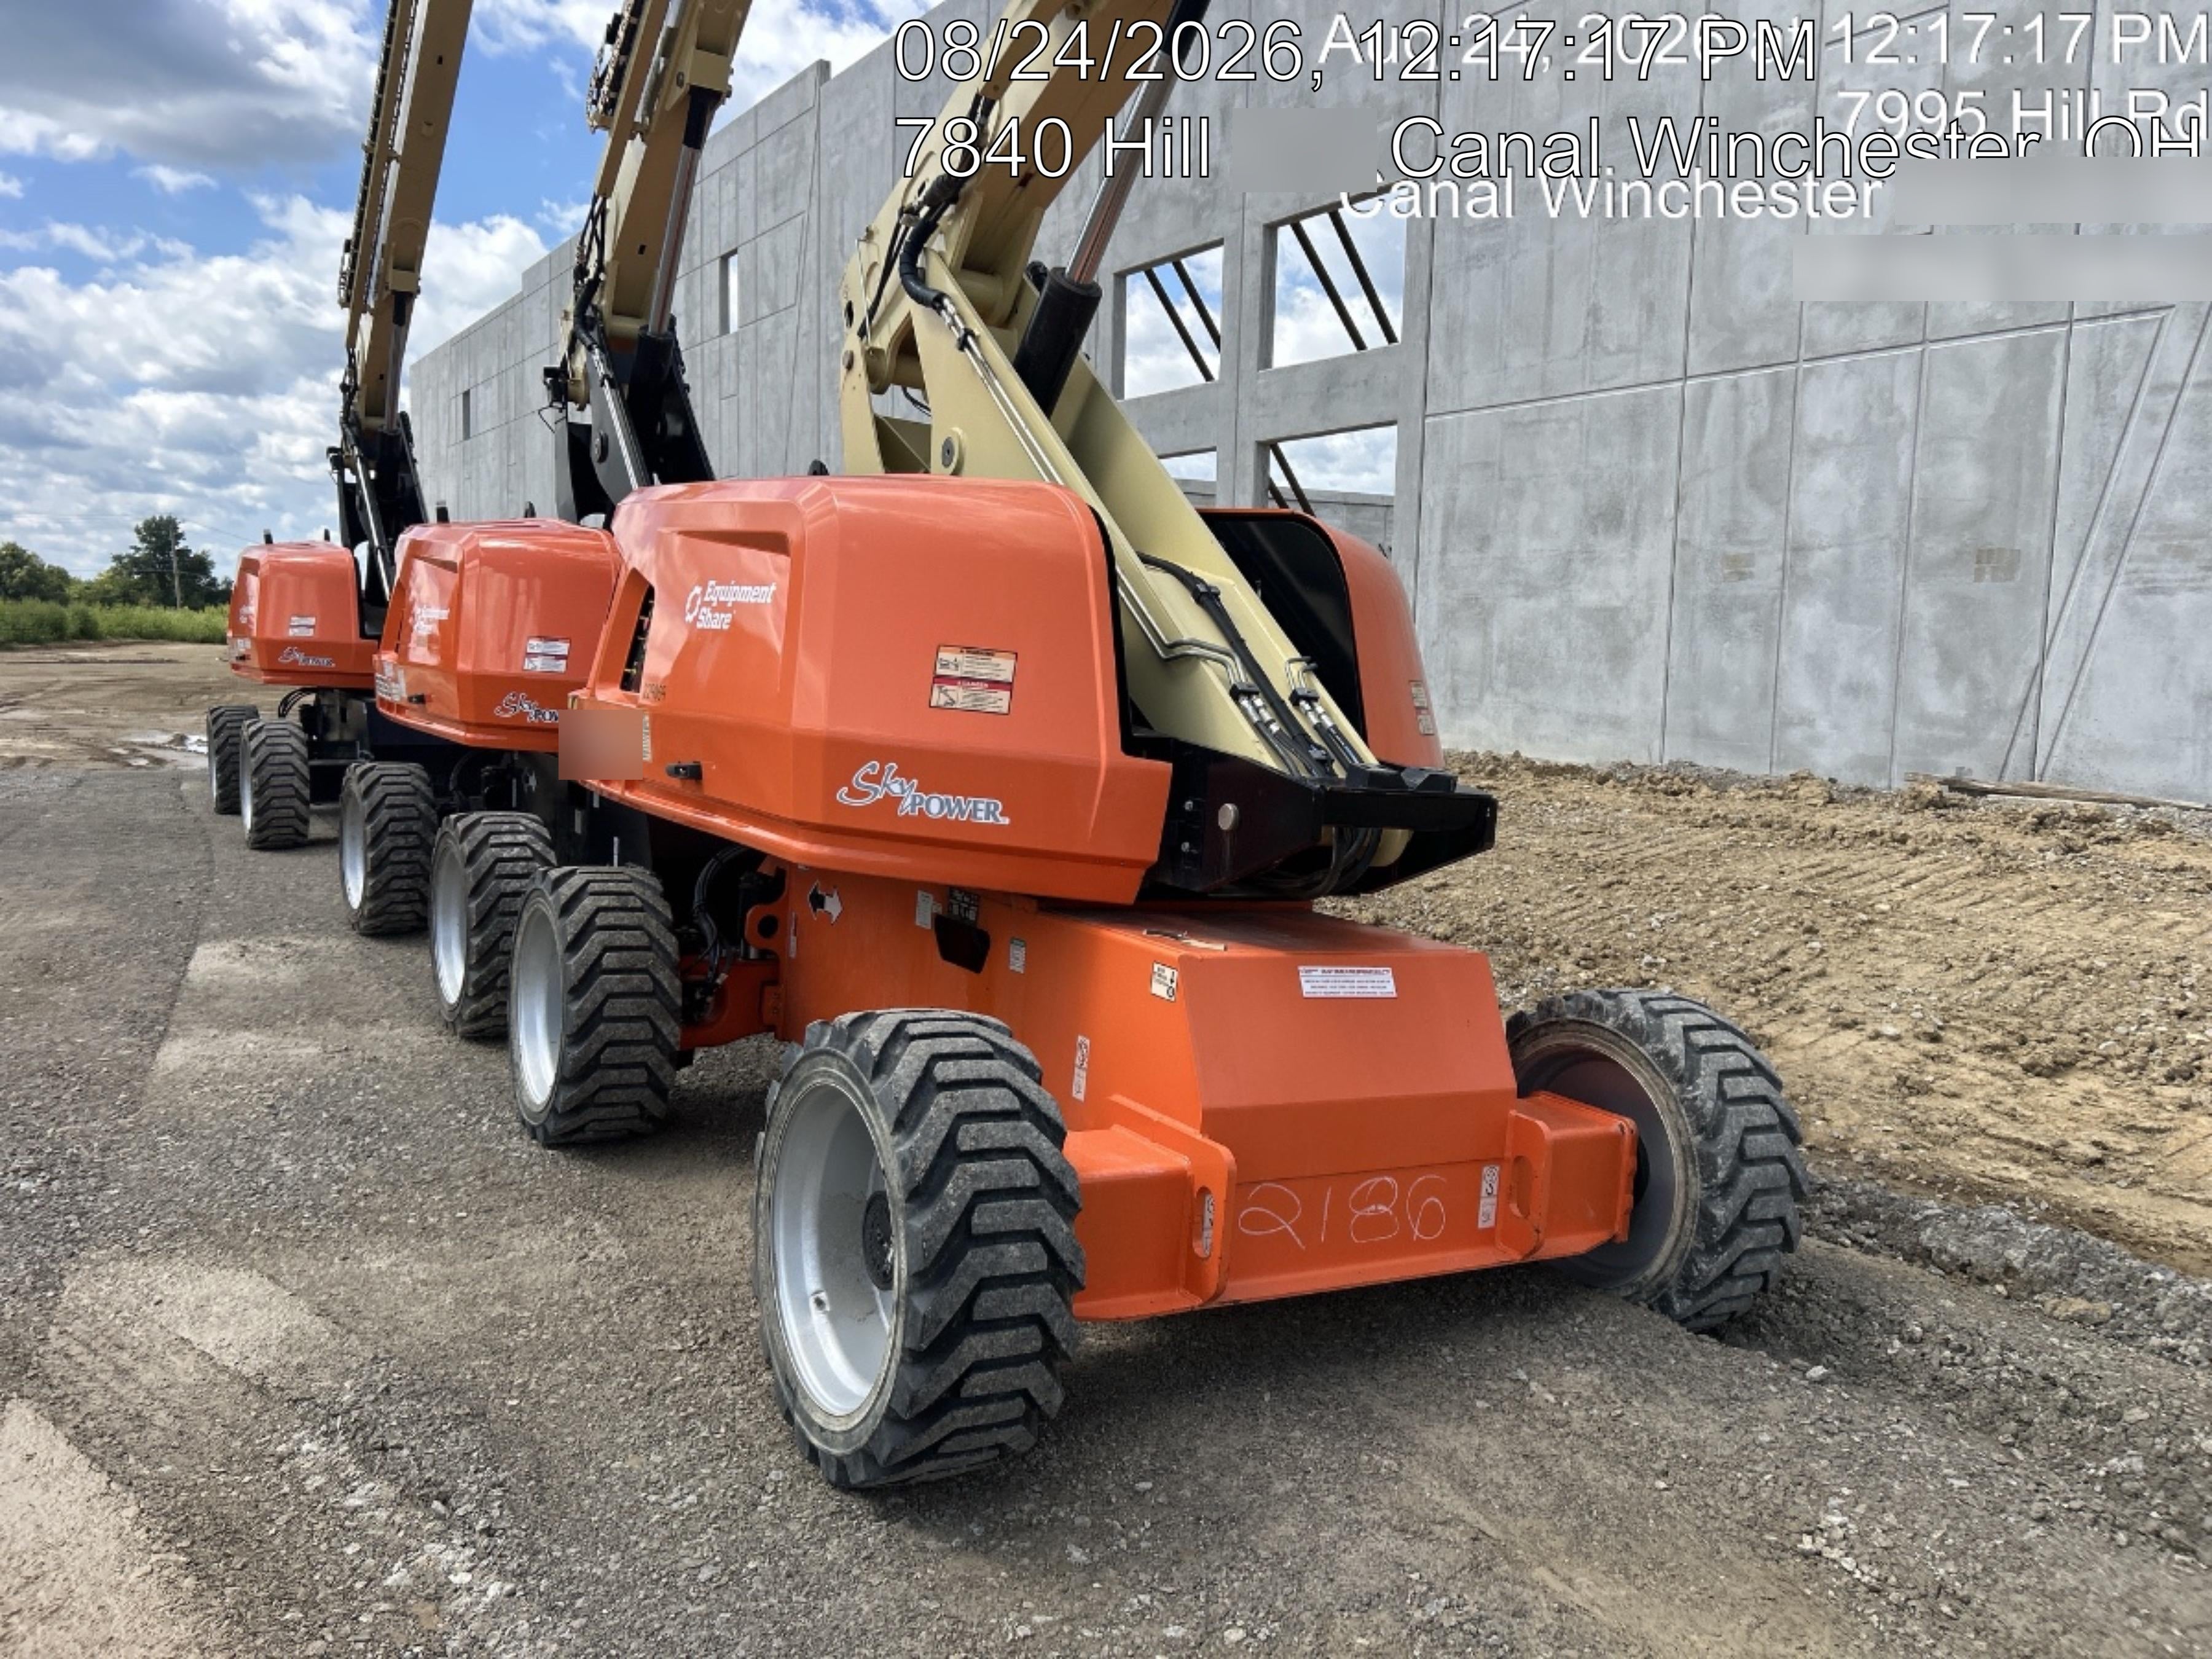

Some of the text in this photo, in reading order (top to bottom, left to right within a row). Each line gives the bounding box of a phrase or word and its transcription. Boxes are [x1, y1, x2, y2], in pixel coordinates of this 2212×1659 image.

[704, 579, 777, 607] Equipment
[696, 606, 733, 630] Share
[1238, 1174, 1446, 1250] 2186
